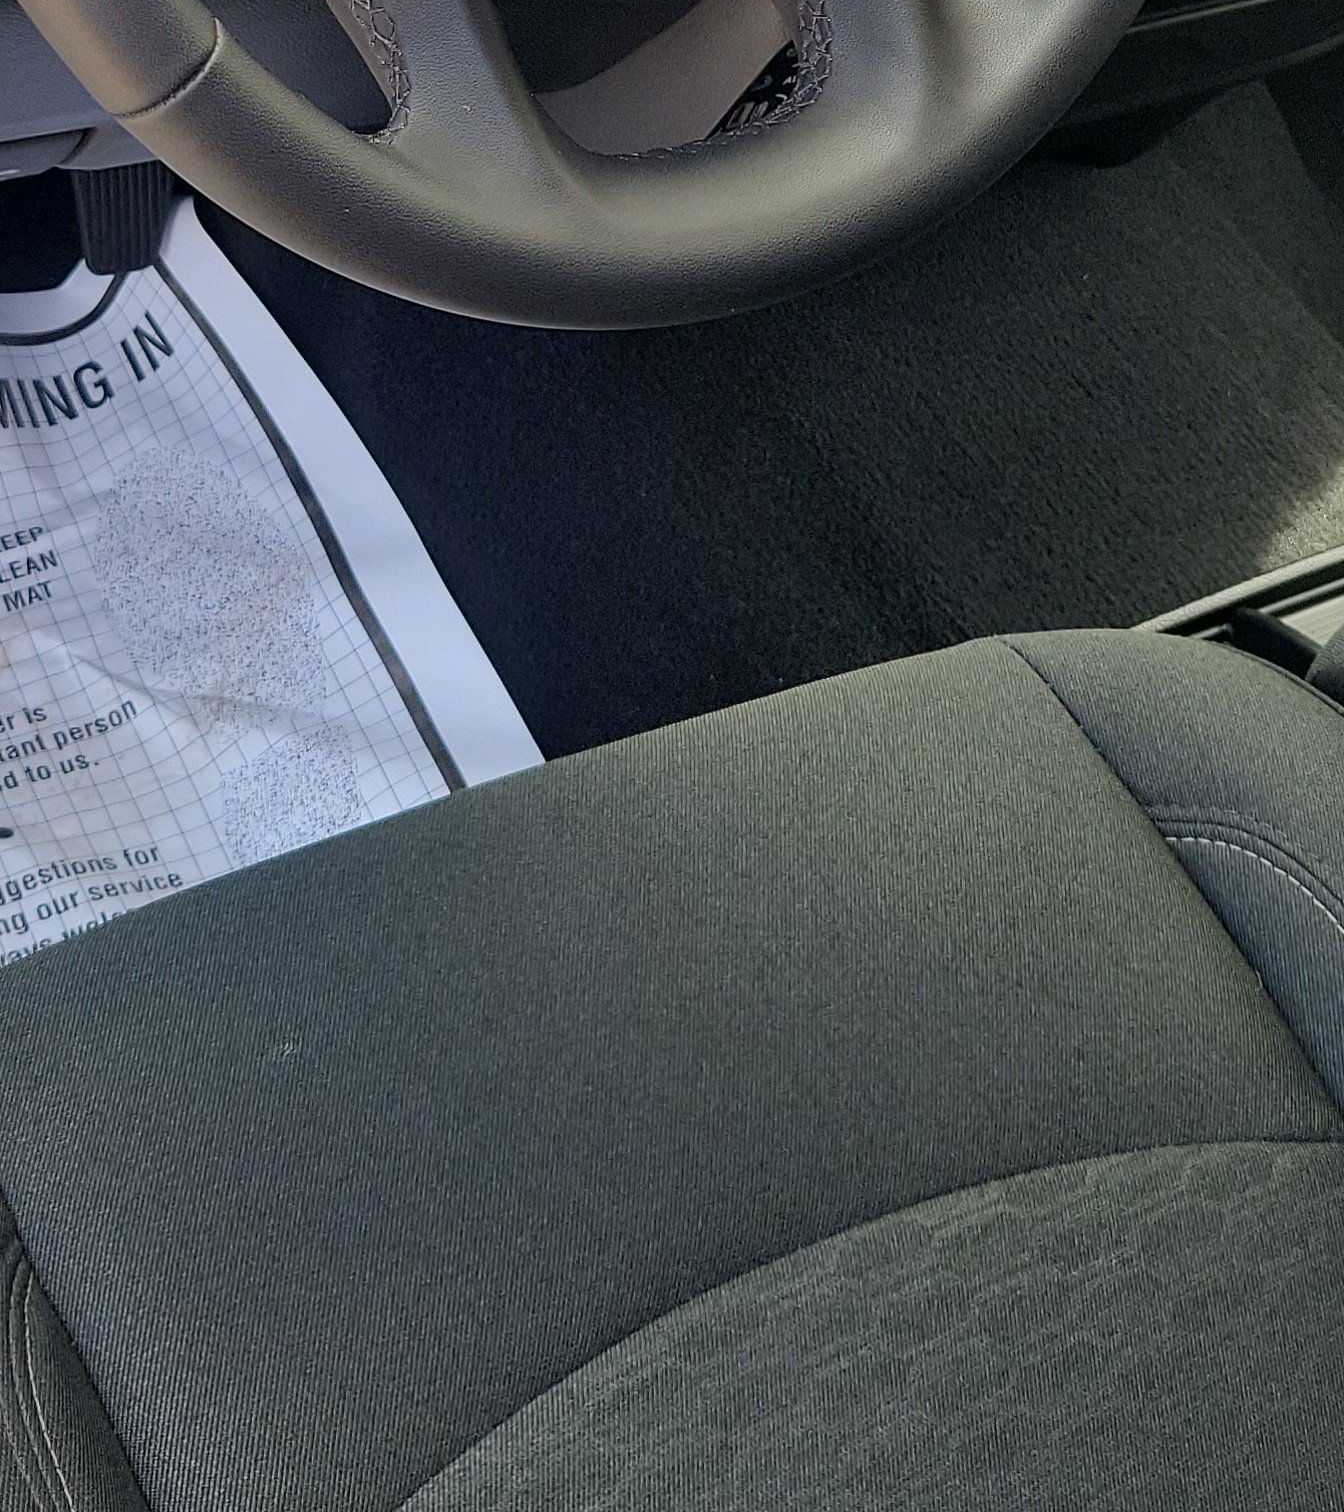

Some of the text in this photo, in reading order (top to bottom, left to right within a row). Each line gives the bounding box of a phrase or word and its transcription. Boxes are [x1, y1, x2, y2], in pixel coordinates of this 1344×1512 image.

[119, 310, 175, 382] IN
[2, 579, 55, 612] MAT
[23, 704, 48, 725] is
[52, 699, 138, 751] person
[25, 763, 53, 783] to
[60, 752, 100, 775] us.
[123, 845, 159, 868] for
[36, 889, 80, 921] our
[88, 870, 184, 902] service
